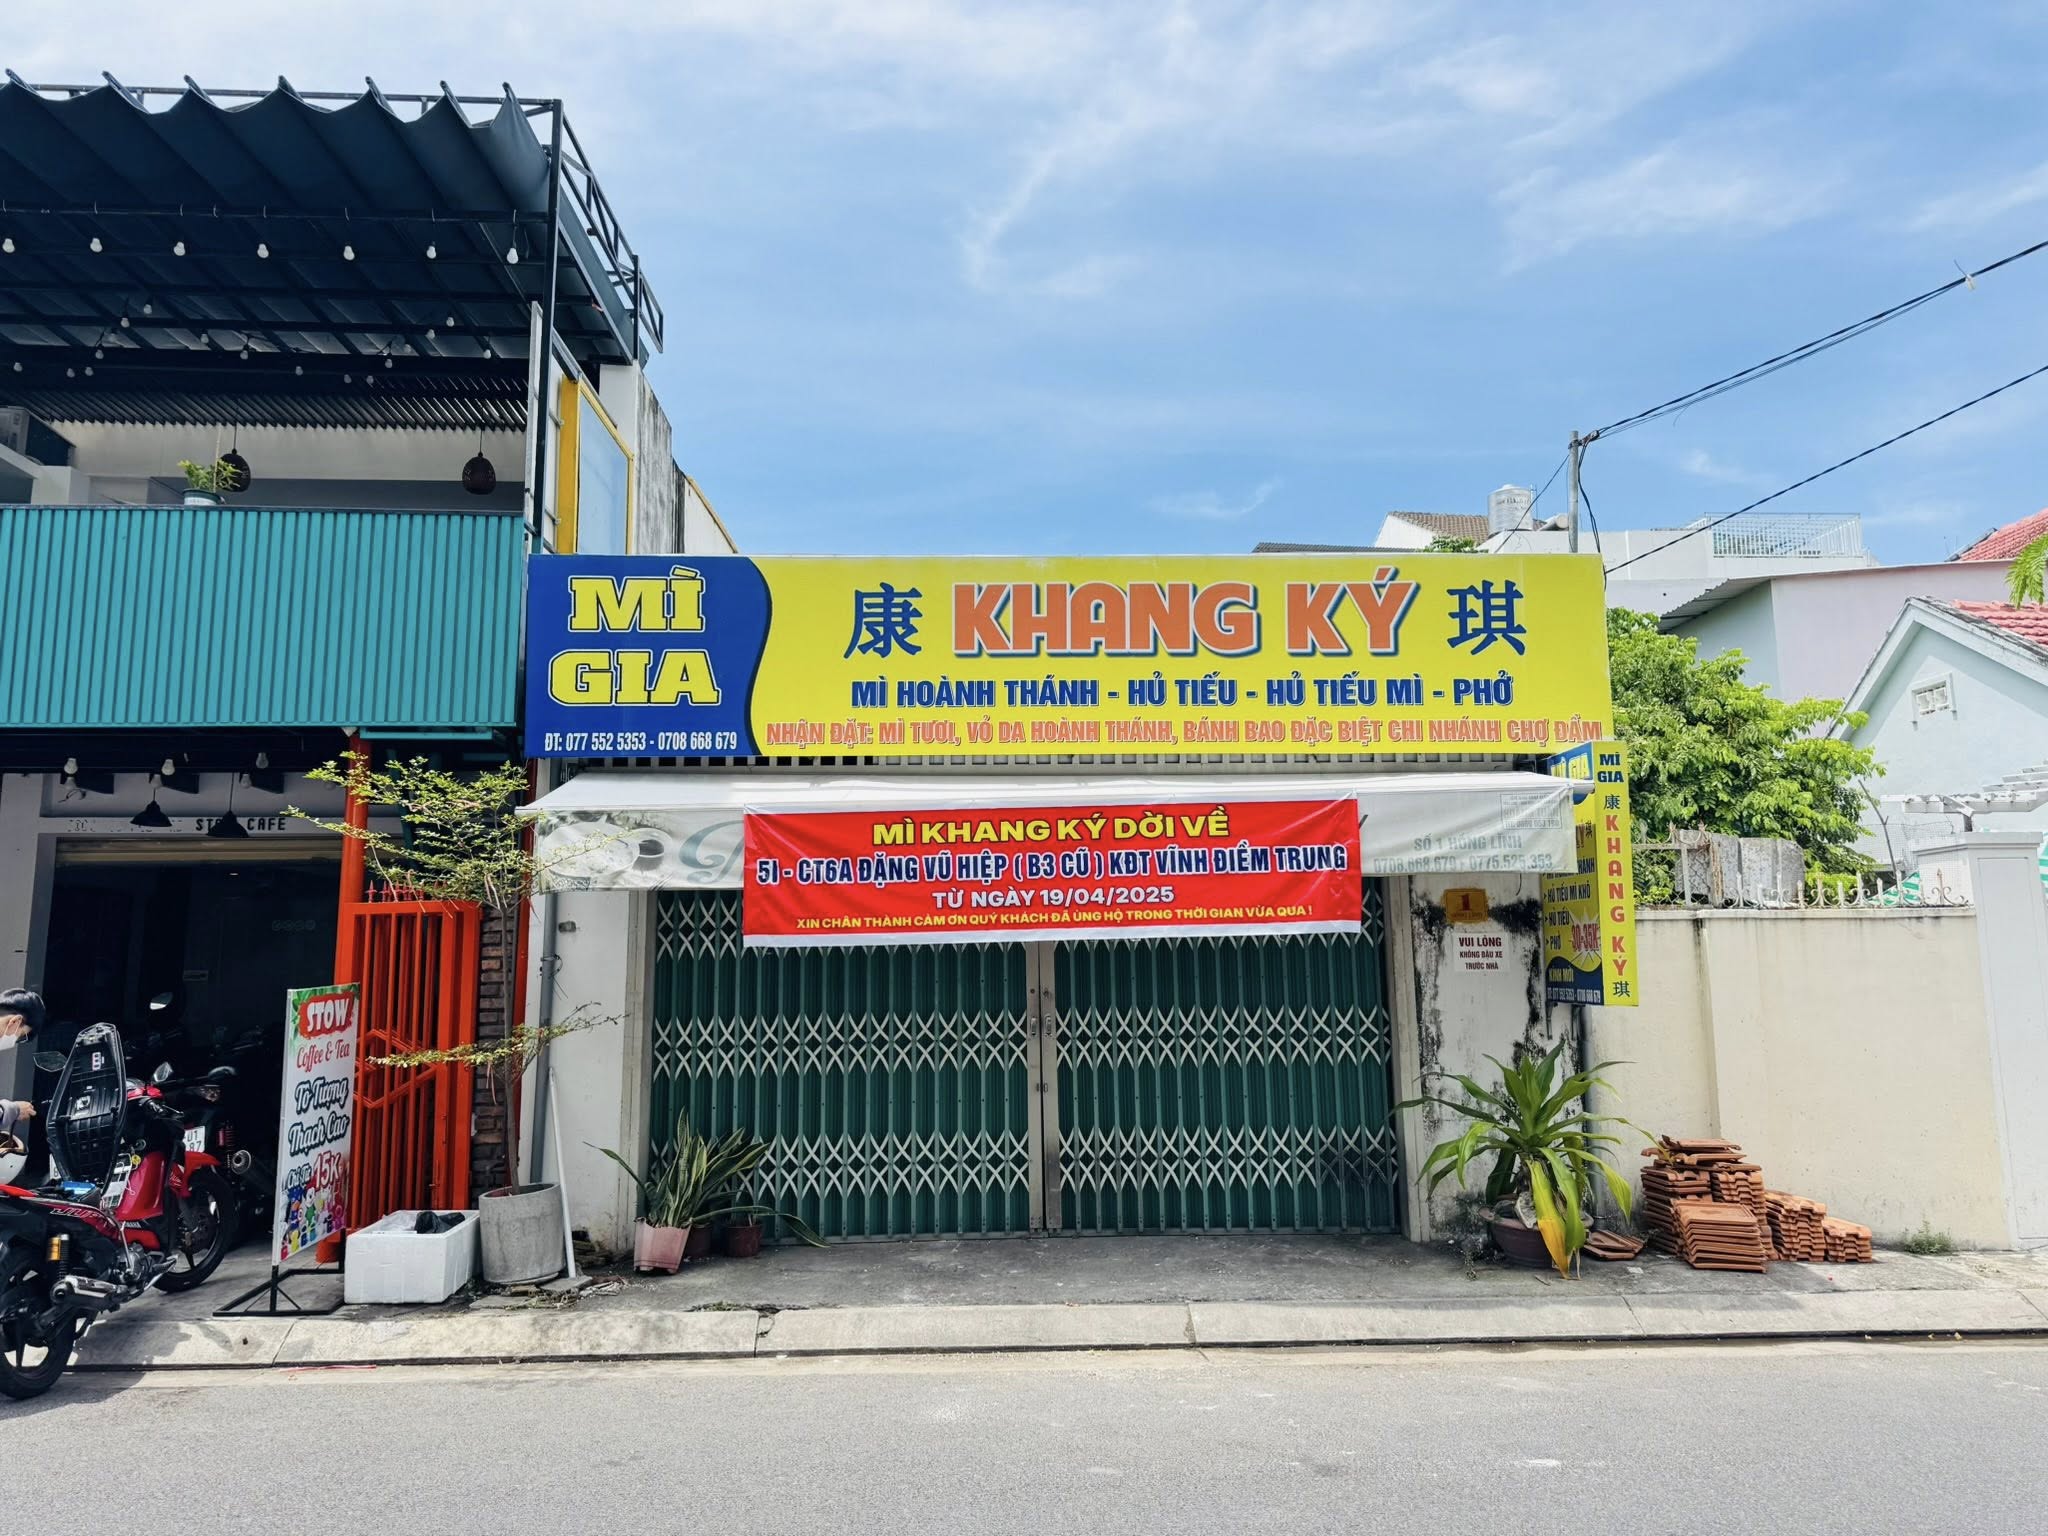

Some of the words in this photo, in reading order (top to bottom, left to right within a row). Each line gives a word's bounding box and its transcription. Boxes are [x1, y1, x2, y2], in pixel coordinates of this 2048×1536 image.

[568, 565, 705, 632] MÌ
[952, 580, 1262, 658] KHANG
[1285, 566, 1421, 656] KÝ
[842, 582, 923, 659] 康
[1446, 580, 1527, 656] 琪
[548, 649, 722, 706] GIA
[851, 676, 888, 708] MÌ
[897, 675, 995, 708] HOÀNH
[1003, 674, 1100, 707] THÁNH
[1107, 690, 1119, 699] -
[1128, 671, 1168, 707] HỦ
[1175, 671, 1238, 707] TIẾU
[1246, 690, 1259, 699] -
[1266, 671, 1306, 707] HỦ
[1313, 671, 1378, 707] TIẾU
[1386, 673, 1424, 706] MÌ
[1432, 690, 1445, 698] -
[1453, 670, 1514, 706] PHỞ
[545, 733, 563, 751] ĐT:
[566, 733, 589, 751] 077
[591, 733, 613, 751] 552
[616, 732, 647, 751] 5353
[658, 731, 687, 750] 0708
[690, 731, 713, 750] 668
[715, 731, 737, 750] 679
[766, 718, 825, 749] NHẬN
[829, 717, 874, 749] ĐẶT:
[879, 717, 905, 745] MÌ
[909, 719, 962, 747] TƯƠI,
[966, 714, 994, 743] VỎ
[999, 720, 1027, 743] DA
[1030, 717, 1101, 743] HOÀNH
[1105, 716, 1179, 746] THÁNH,
[1183, 716, 1240, 743] BÁNH
[1245, 720, 1286, 743] BAO
[1291, 716, 1333, 747] ĐẶC
[1338, 716, 1383, 747] BIỆT
[1388, 720, 1424, 742] CHI
[1428, 716, 1502, 742] NHÁNH
[1506, 718, 1550, 748] CHỢ
[1599, 751, 1621, 766] MÌ
[1597, 770, 1625, 783] GIA
[1603, 793, 1621, 810] 康
[247, 817, 286, 831] CAFE
[872, 816, 916, 846] MÌ
[920, 818, 1052, 844] KHANG
[1056, 812, 1108, 841] KÝ
[1112, 810, 1175, 840] DỜI
[1180, 804, 1231, 838] VỀ
[798, 857, 855, 885] CT6A
[857, 851, 920, 888] ĐẶNG
[923, 849, 953, 881] VŨ
[956, 848, 1009, 886] HIỆP
[1026, 852, 1056, 879] B3
[1060, 846, 1091, 878] CŨ
[1108, 850, 1152, 877] KĐT
[1154, 845, 1209, 875] VĨNH
[1212, 839, 1272, 875] ĐIỀM
[1273, 845, 1348, 872] TRUNG
[1605, 814, 1626, 923] KHANG
[932, 887, 965, 909] TỪ
[970, 885, 1036, 908] NGÀY
[1039, 886, 1175, 908] 19/04/2025
[1461, 893, 1471, 911] 1
[796, 917, 820, 929] XIN
[821, 915, 862, 928] CHÂN
[863, 914, 912, 928] THÀNH
[947, 913, 968, 926] ƠN
[969, 911, 999, 925] QUÝ
[1000, 911, 1050, 925] KHÁCH
[1051, 909, 1072, 923] ĐÃ
[1103, 907, 1124, 923] HỘ
[1126, 908, 1173, 921] TRONG
[1175, 905, 1208, 919] THỜI
[1209, 906, 1244, 918] GIAN
[1245, 904, 1276, 918] VỪA
[1276, 905, 1307, 917] QUA
[1459, 937, 1475, 948] VUI
[1477, 934, 1502, 948] LÒNG
[1494, 950, 1503, 959] XE
[1610, 935, 1629, 977] KÝ
[1612, 980, 1631, 998] 琪
[306, 998, 350, 1033] STOW
[296, 1044, 324, 1073] Coffee
[325, 1041, 333, 1062] &
[335, 1039, 350, 1060] Tea
[288, 1116, 325, 1157] Thạch
[325, 1111, 350, 1144] Cao
[312, 1150, 341, 1191] 15K
